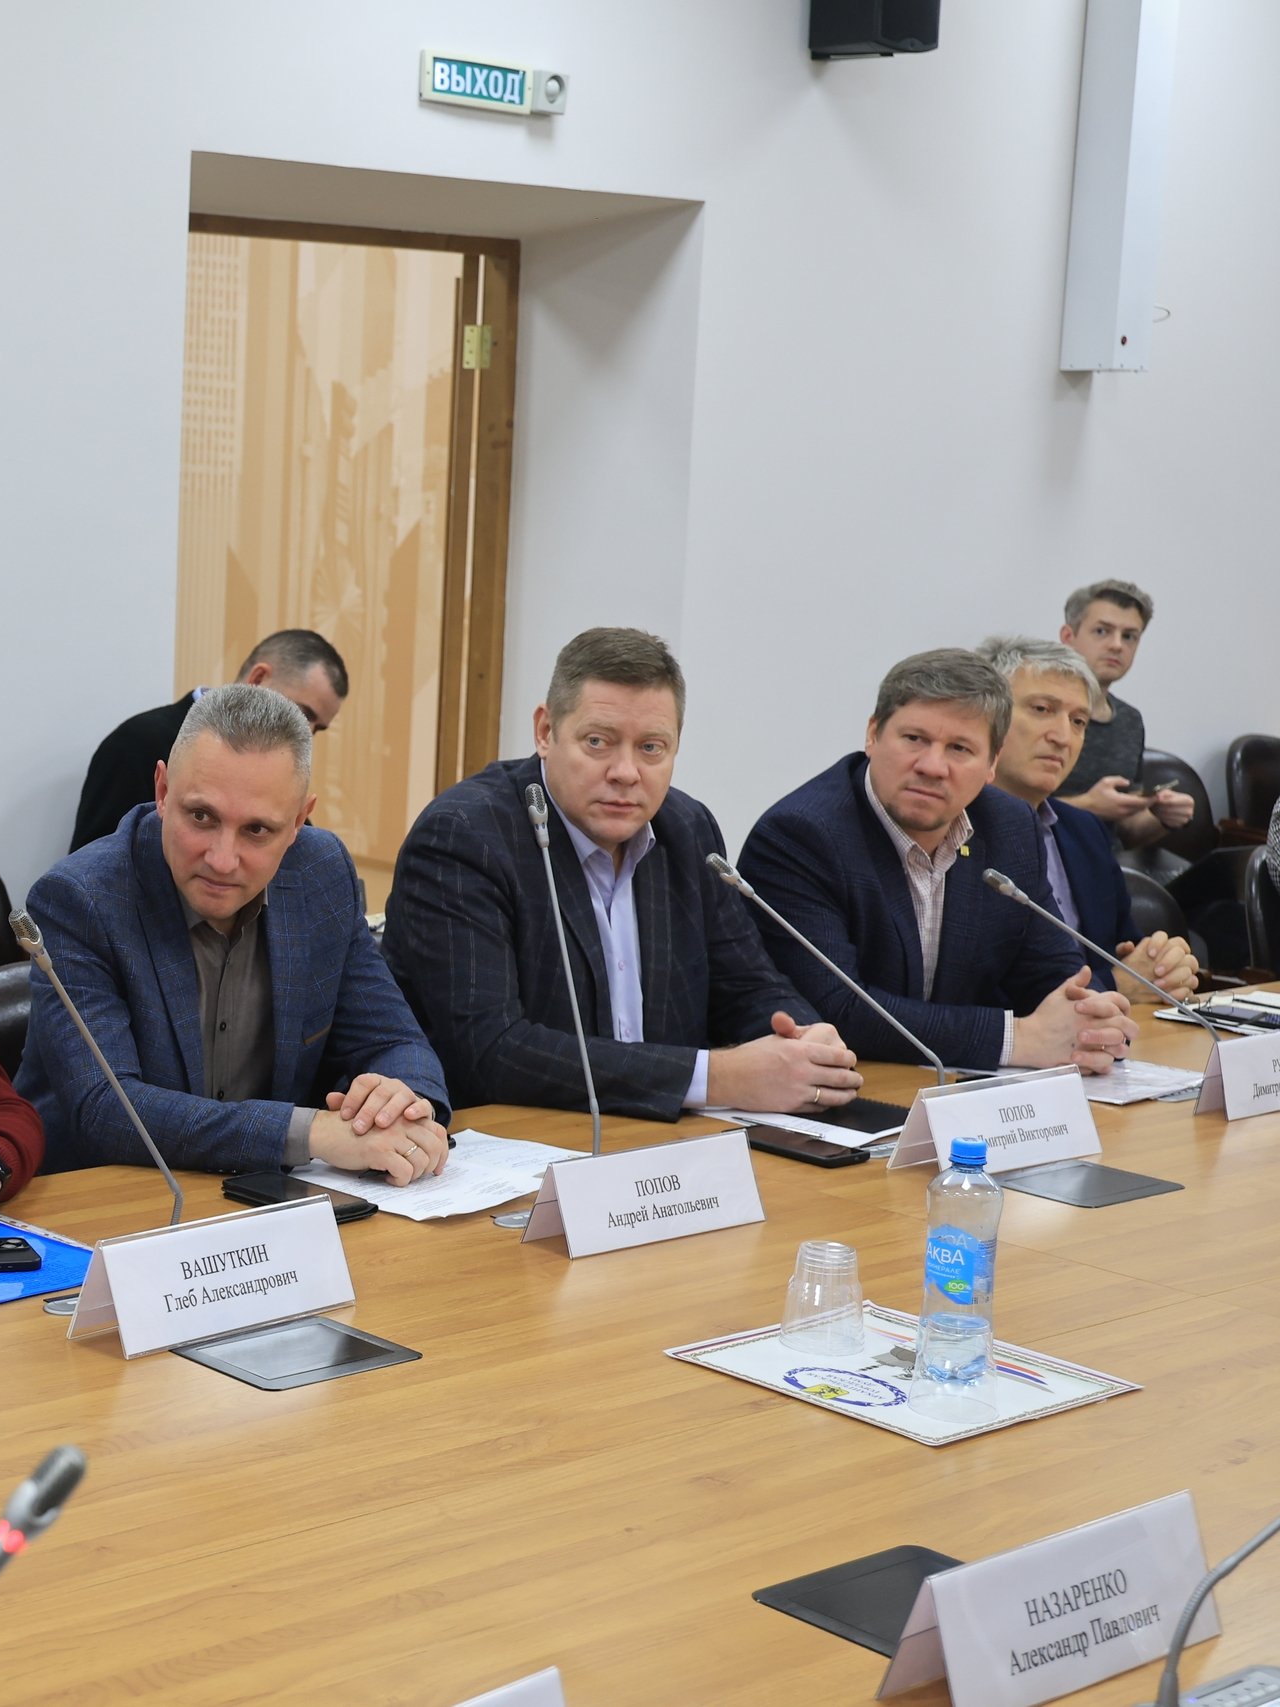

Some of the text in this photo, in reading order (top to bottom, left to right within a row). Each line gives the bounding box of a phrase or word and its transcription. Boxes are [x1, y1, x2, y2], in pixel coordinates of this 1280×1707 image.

[434, 61, 522, 104] ВЫХОД
[999, 1103, 1036, 1124] ПОПОВ
[1019, 1123, 1069, 1144] Викторович
[634, 1174, 681, 1197] ПОПОВ
[608, 1196, 720, 1229] Андрей Анатольевич
[180, 1243, 270, 1280] ВАШУТКИН
[926, 1241, 965, 1266] АКВА
[163, 1269, 299, 1313] Глеб Александрович
[1024, 1568, 1128, 1627] НАЗАРЕНКО
[1010, 1603, 1161, 1676] Александр Павлович
